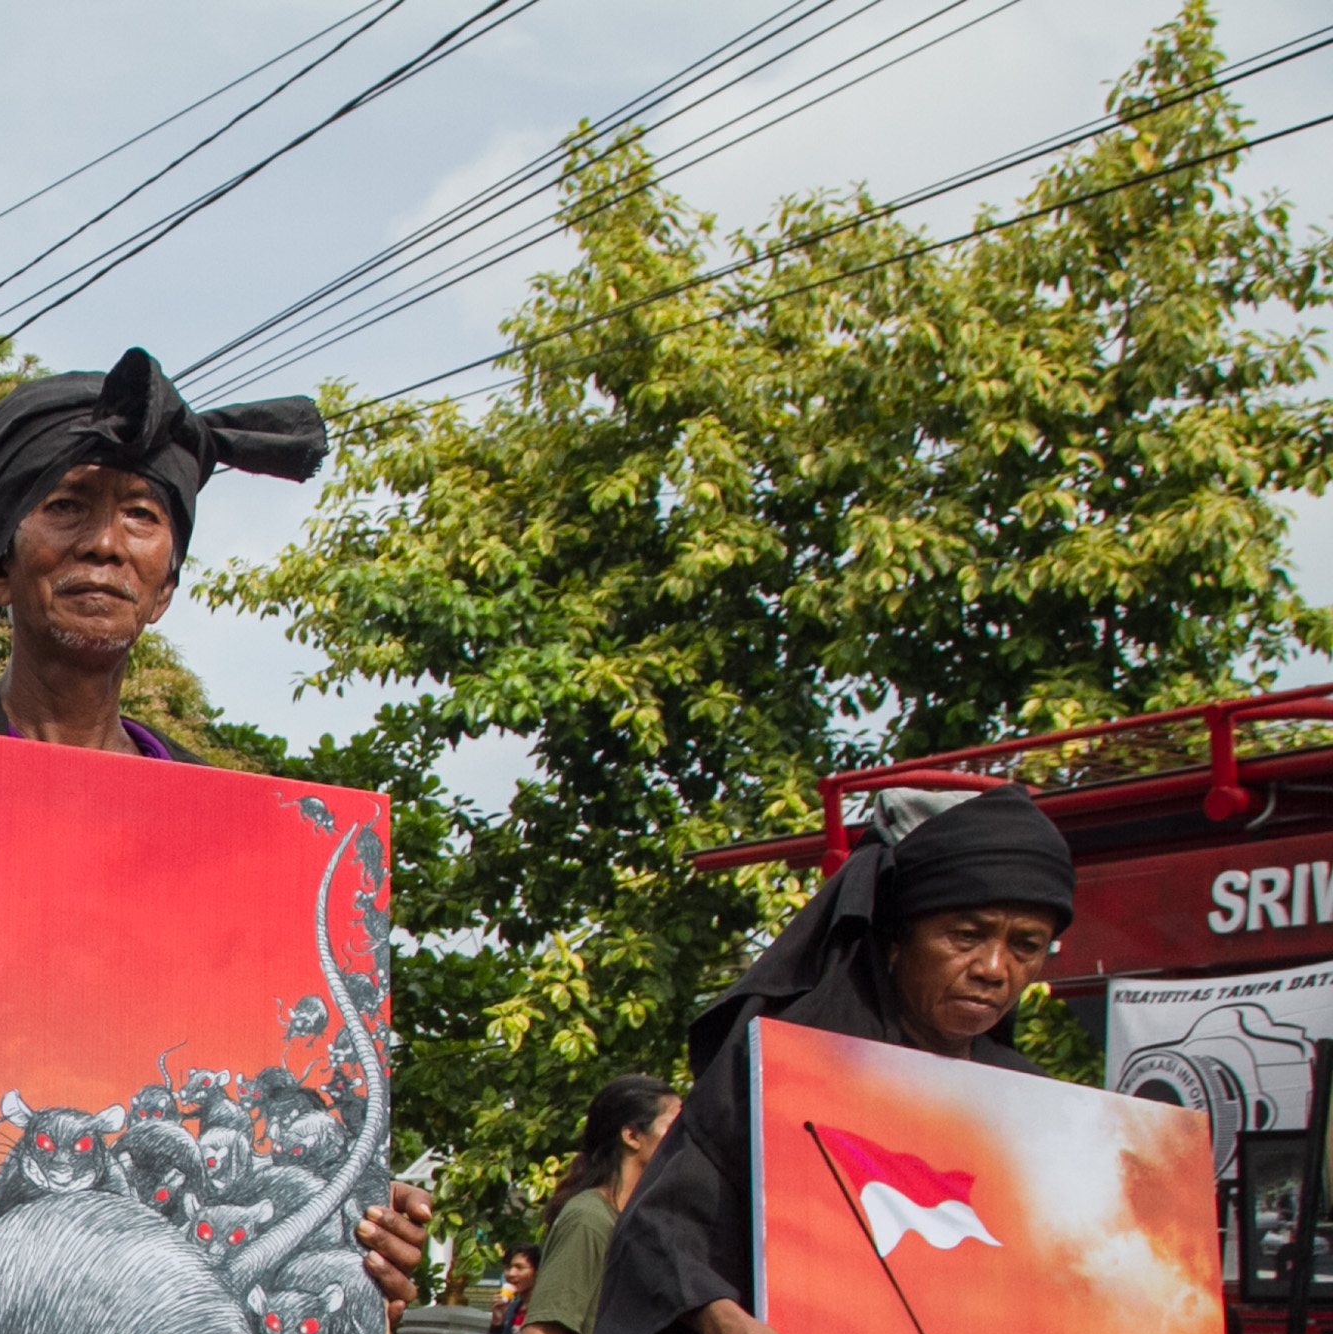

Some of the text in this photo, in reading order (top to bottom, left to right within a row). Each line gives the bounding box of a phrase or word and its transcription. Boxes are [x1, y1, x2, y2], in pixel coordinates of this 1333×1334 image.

[1114, 972, 1333, 1004] KREATIFITAS TANPA BAT
